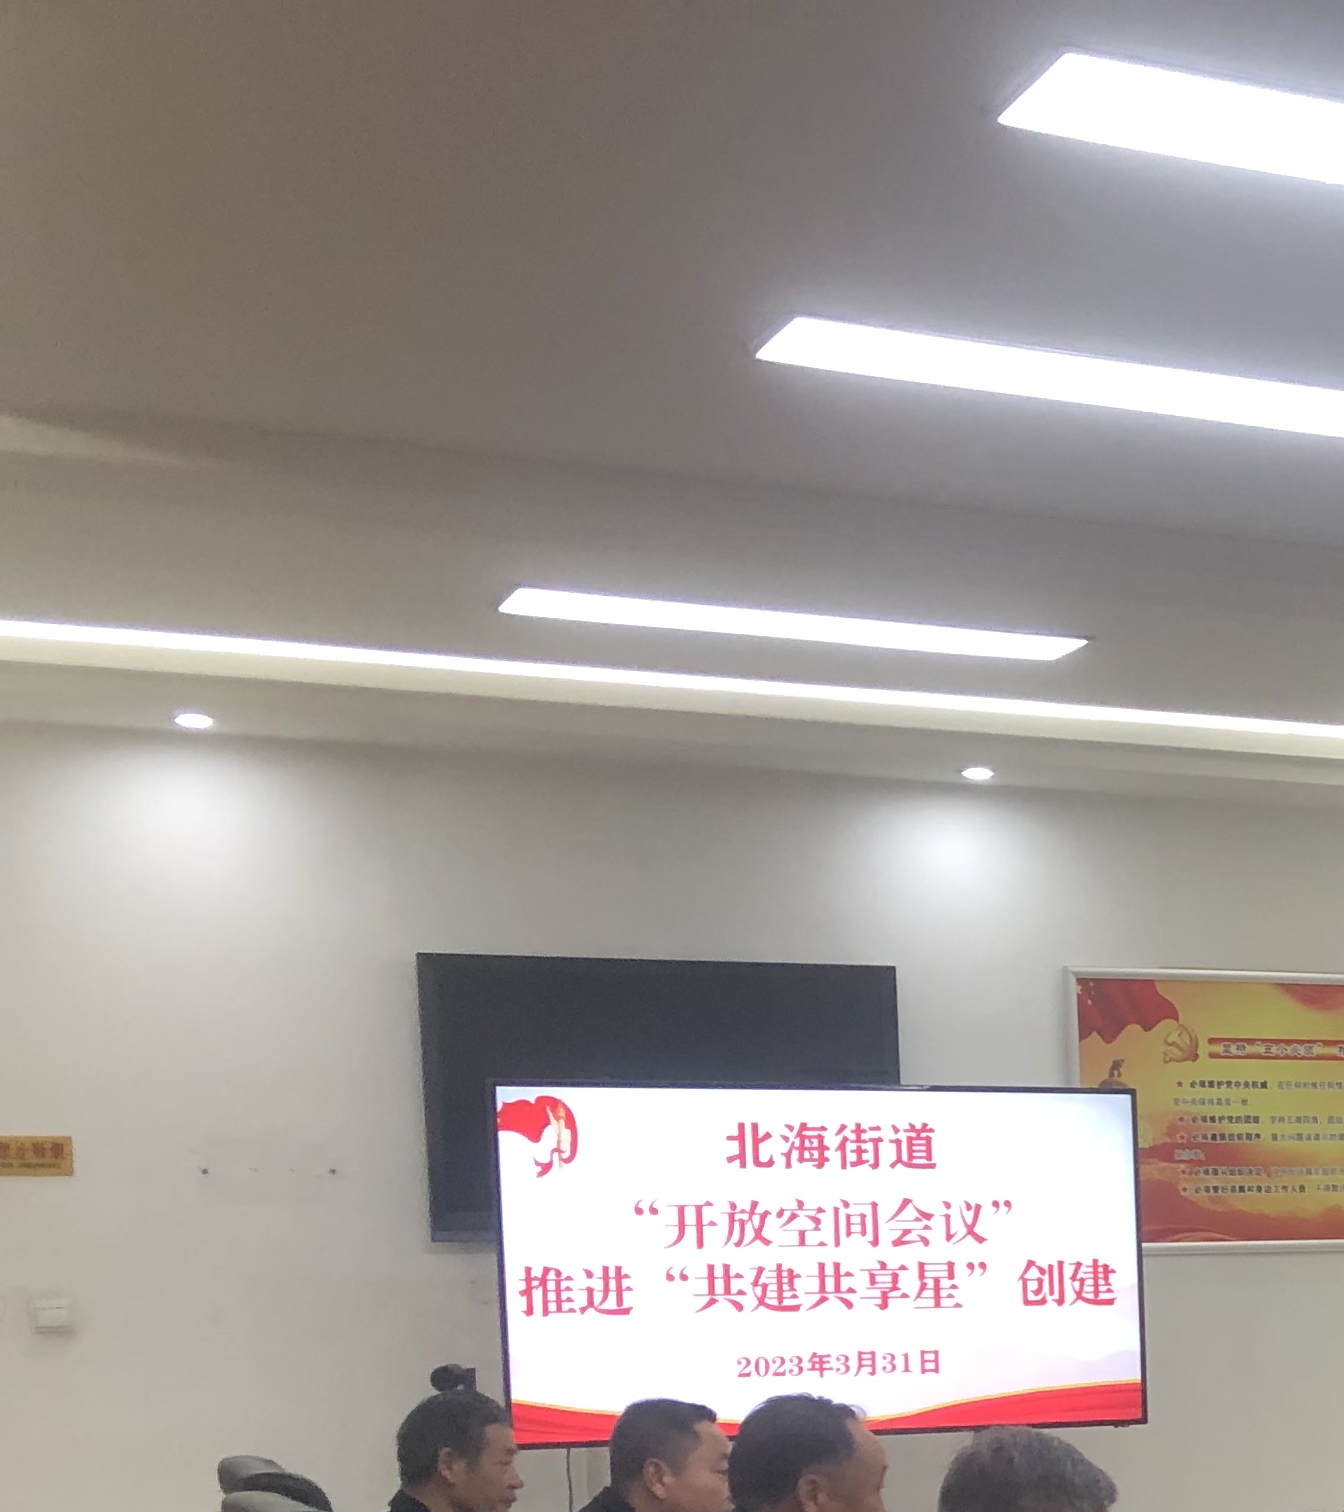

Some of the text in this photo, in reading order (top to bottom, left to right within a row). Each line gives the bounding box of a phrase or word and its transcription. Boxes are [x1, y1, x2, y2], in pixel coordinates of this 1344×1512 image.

[726, 1121, 937, 1170] 北海街道
[634, 1197, 1013, 1250] “开放空间会议”
[738, 1349, 941, 1379] 2023年3月31日
